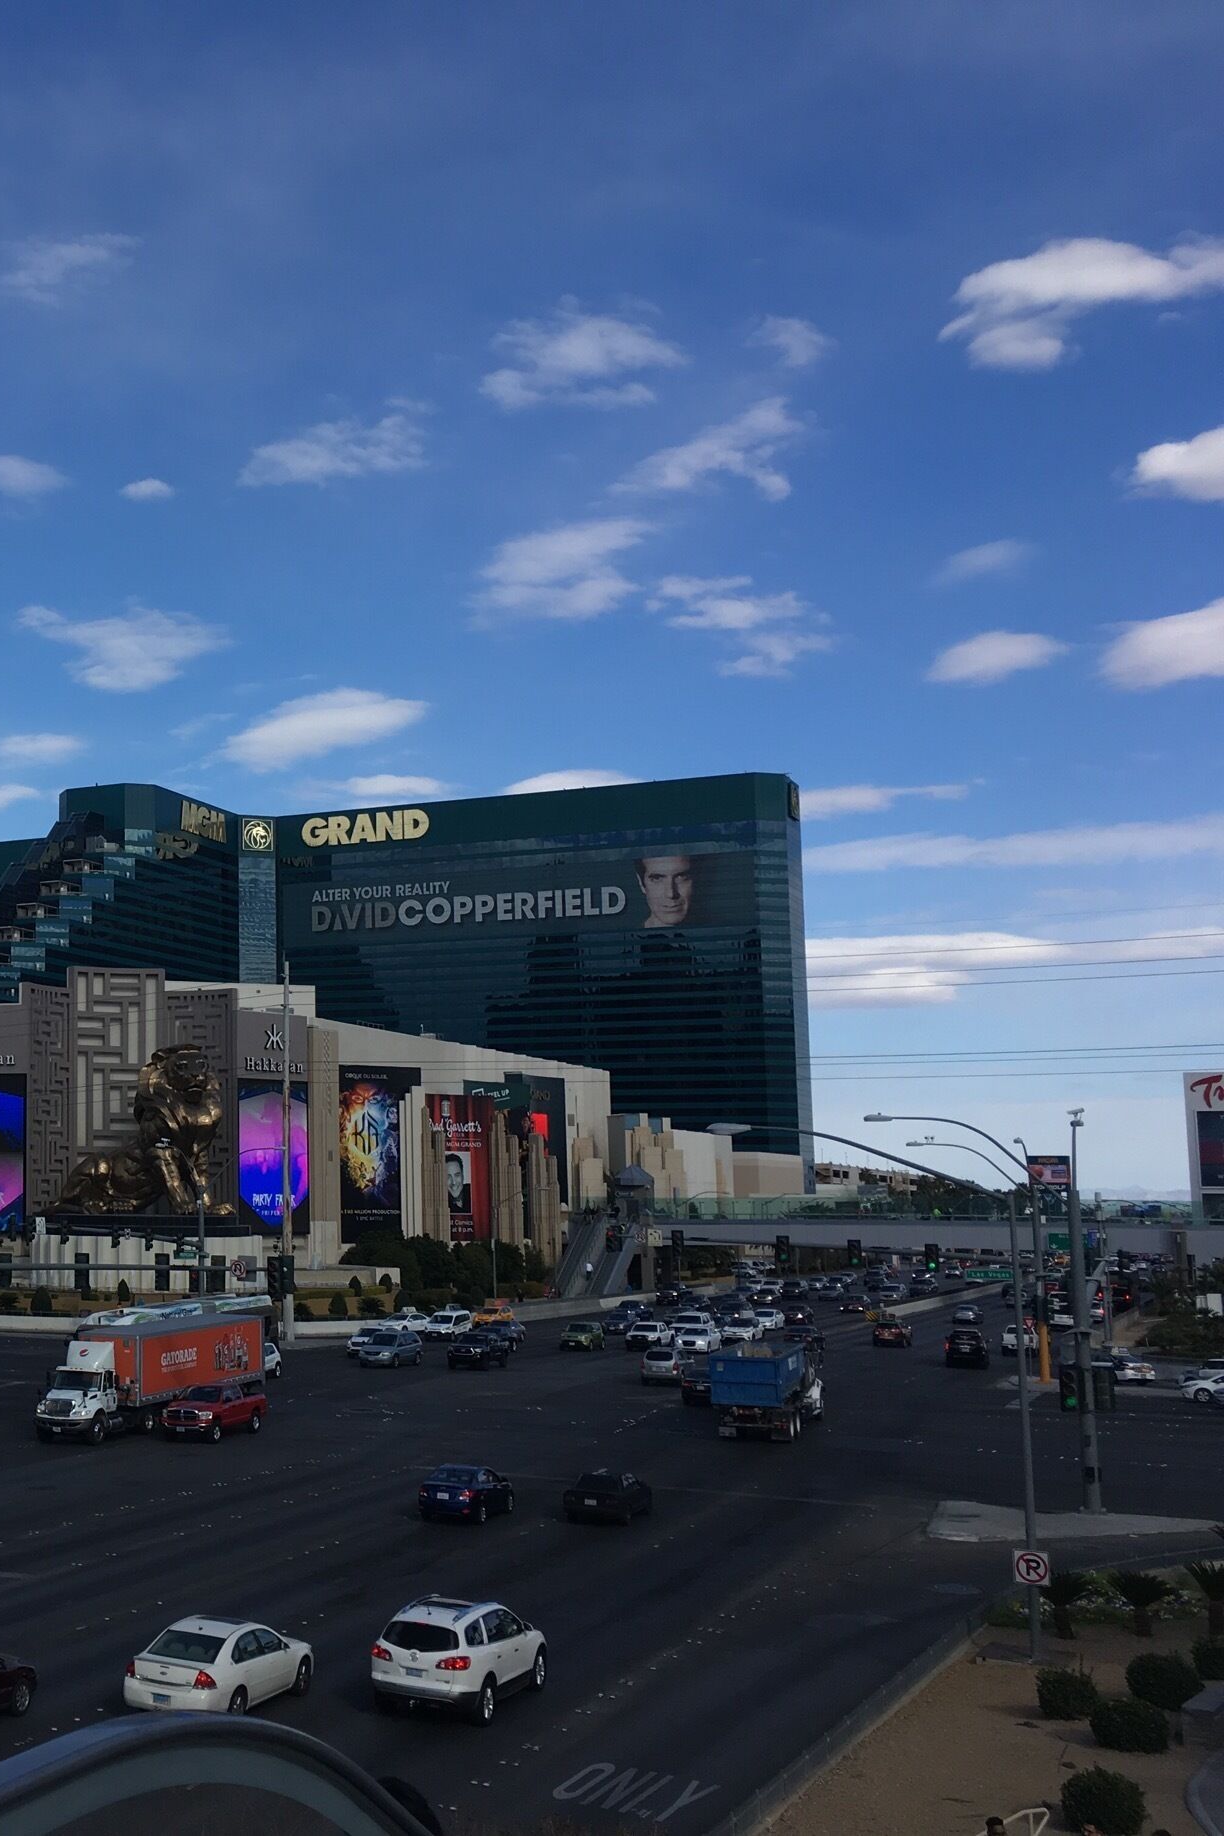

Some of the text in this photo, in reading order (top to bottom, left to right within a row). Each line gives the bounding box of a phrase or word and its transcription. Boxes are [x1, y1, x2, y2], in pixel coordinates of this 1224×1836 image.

[180, 799, 227, 844] MGM
[301, 809, 430, 847] GRAND
[312, 881, 450, 903] ALTER YOUR REALITY
[245, 1056, 304, 1073] Hakkaan
[446, 1118, 482, 1138] Garrett's
[252, 1193, 296, 1207] PARTY FAR
[987, 1271, 1011, 1279] Vegas
[161, 1347, 197, 1366] GATORADE
[552, 1762, 722, 1823] ONLY
